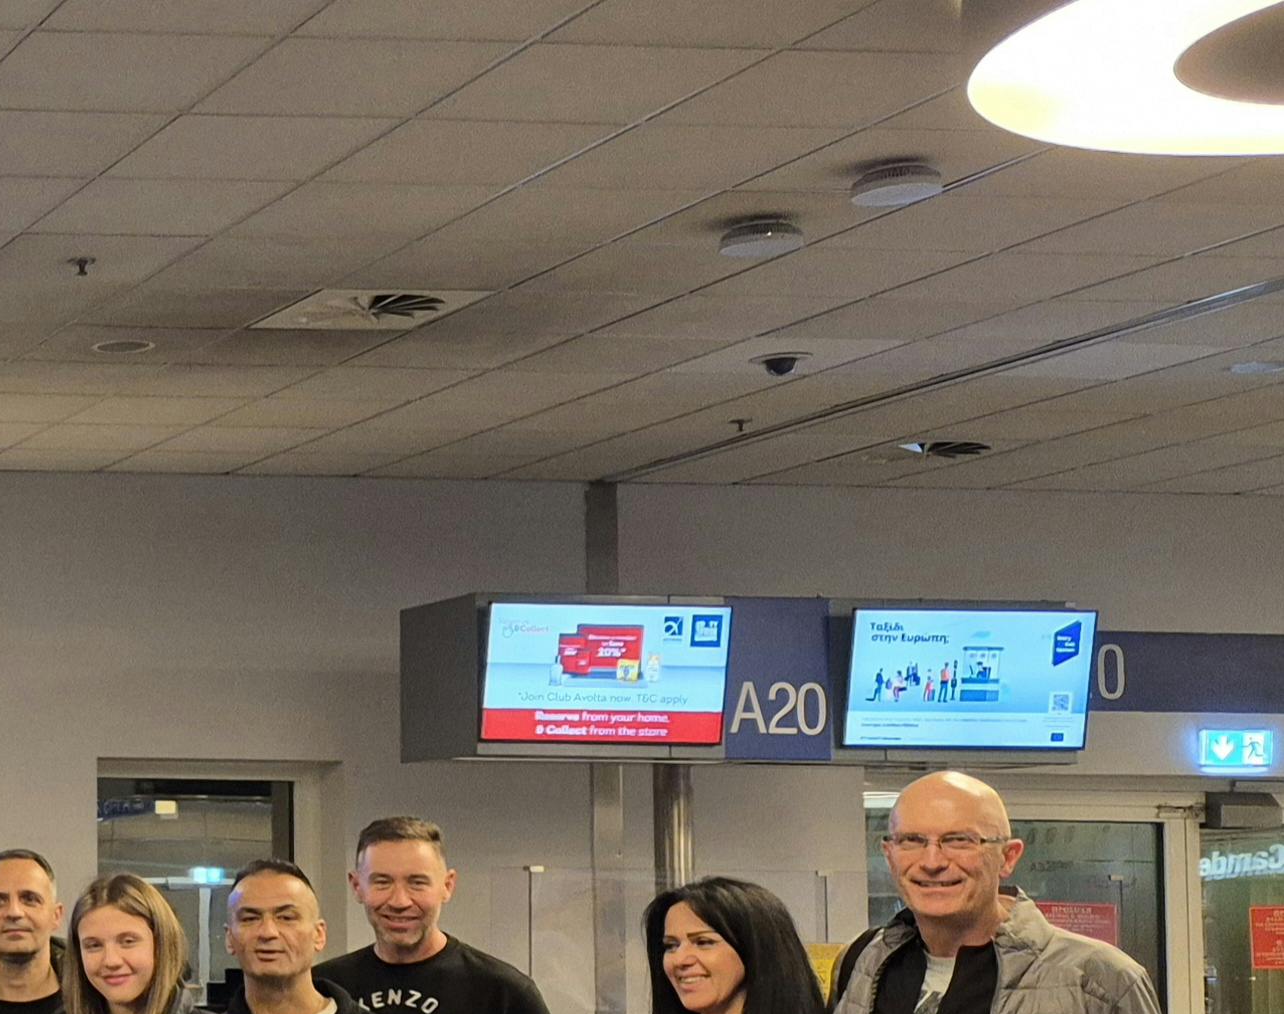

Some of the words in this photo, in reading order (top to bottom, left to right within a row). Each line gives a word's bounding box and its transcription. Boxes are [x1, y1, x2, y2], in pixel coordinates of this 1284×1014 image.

[870, 622, 905, 633] Ταξίδι
[871, 634, 898, 643] στην
[1089, 643, 1126, 700] 0
[547, 692, 572, 702] Club
[574, 692, 608, 703] Avolta
[660, 694, 688, 705] apply
[729, 681, 828, 736] A20
[581, 711, 609, 722] from
[610, 713, 636, 725] your
[589, 725, 616, 736] from
[618, 726, 636, 737] the
[638, 727, 668, 737] store
